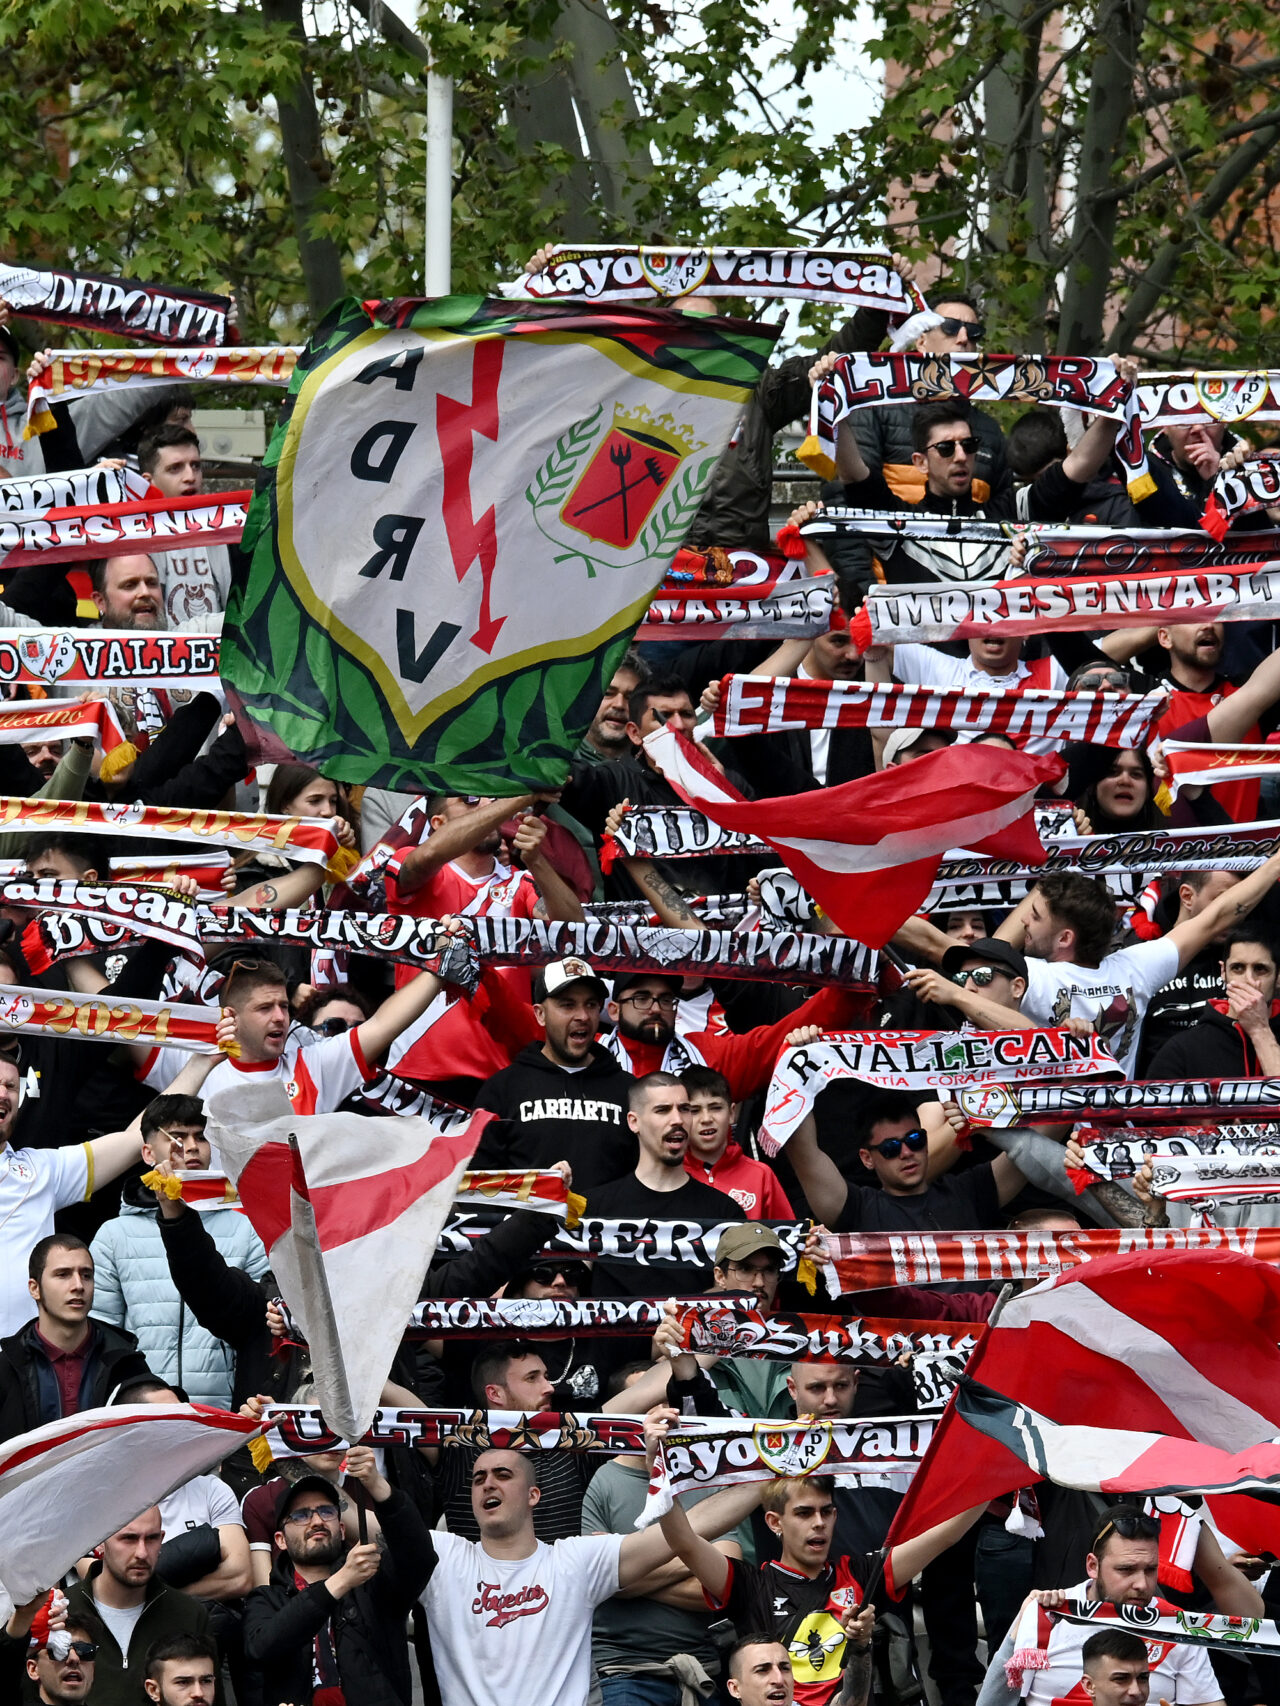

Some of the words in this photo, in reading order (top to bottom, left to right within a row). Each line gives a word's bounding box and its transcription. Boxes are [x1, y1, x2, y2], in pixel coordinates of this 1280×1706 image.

[46, 349, 171, 396] 1924
[644, 587, 834, 627] TABLES
[726, 674, 808, 736] EL
[821, 678, 1004, 734] PUTO
[159, 804, 302, 852] 2024
[41, 996, 174, 1043] 2024
[927, 1071, 998, 1086] CORAJE
[1015, 1060, 1100, 1078] NOBLEZA
[520, 1098, 623, 1126] CARHARTT
[1021, 1082, 1212, 1112] HISTORIA
